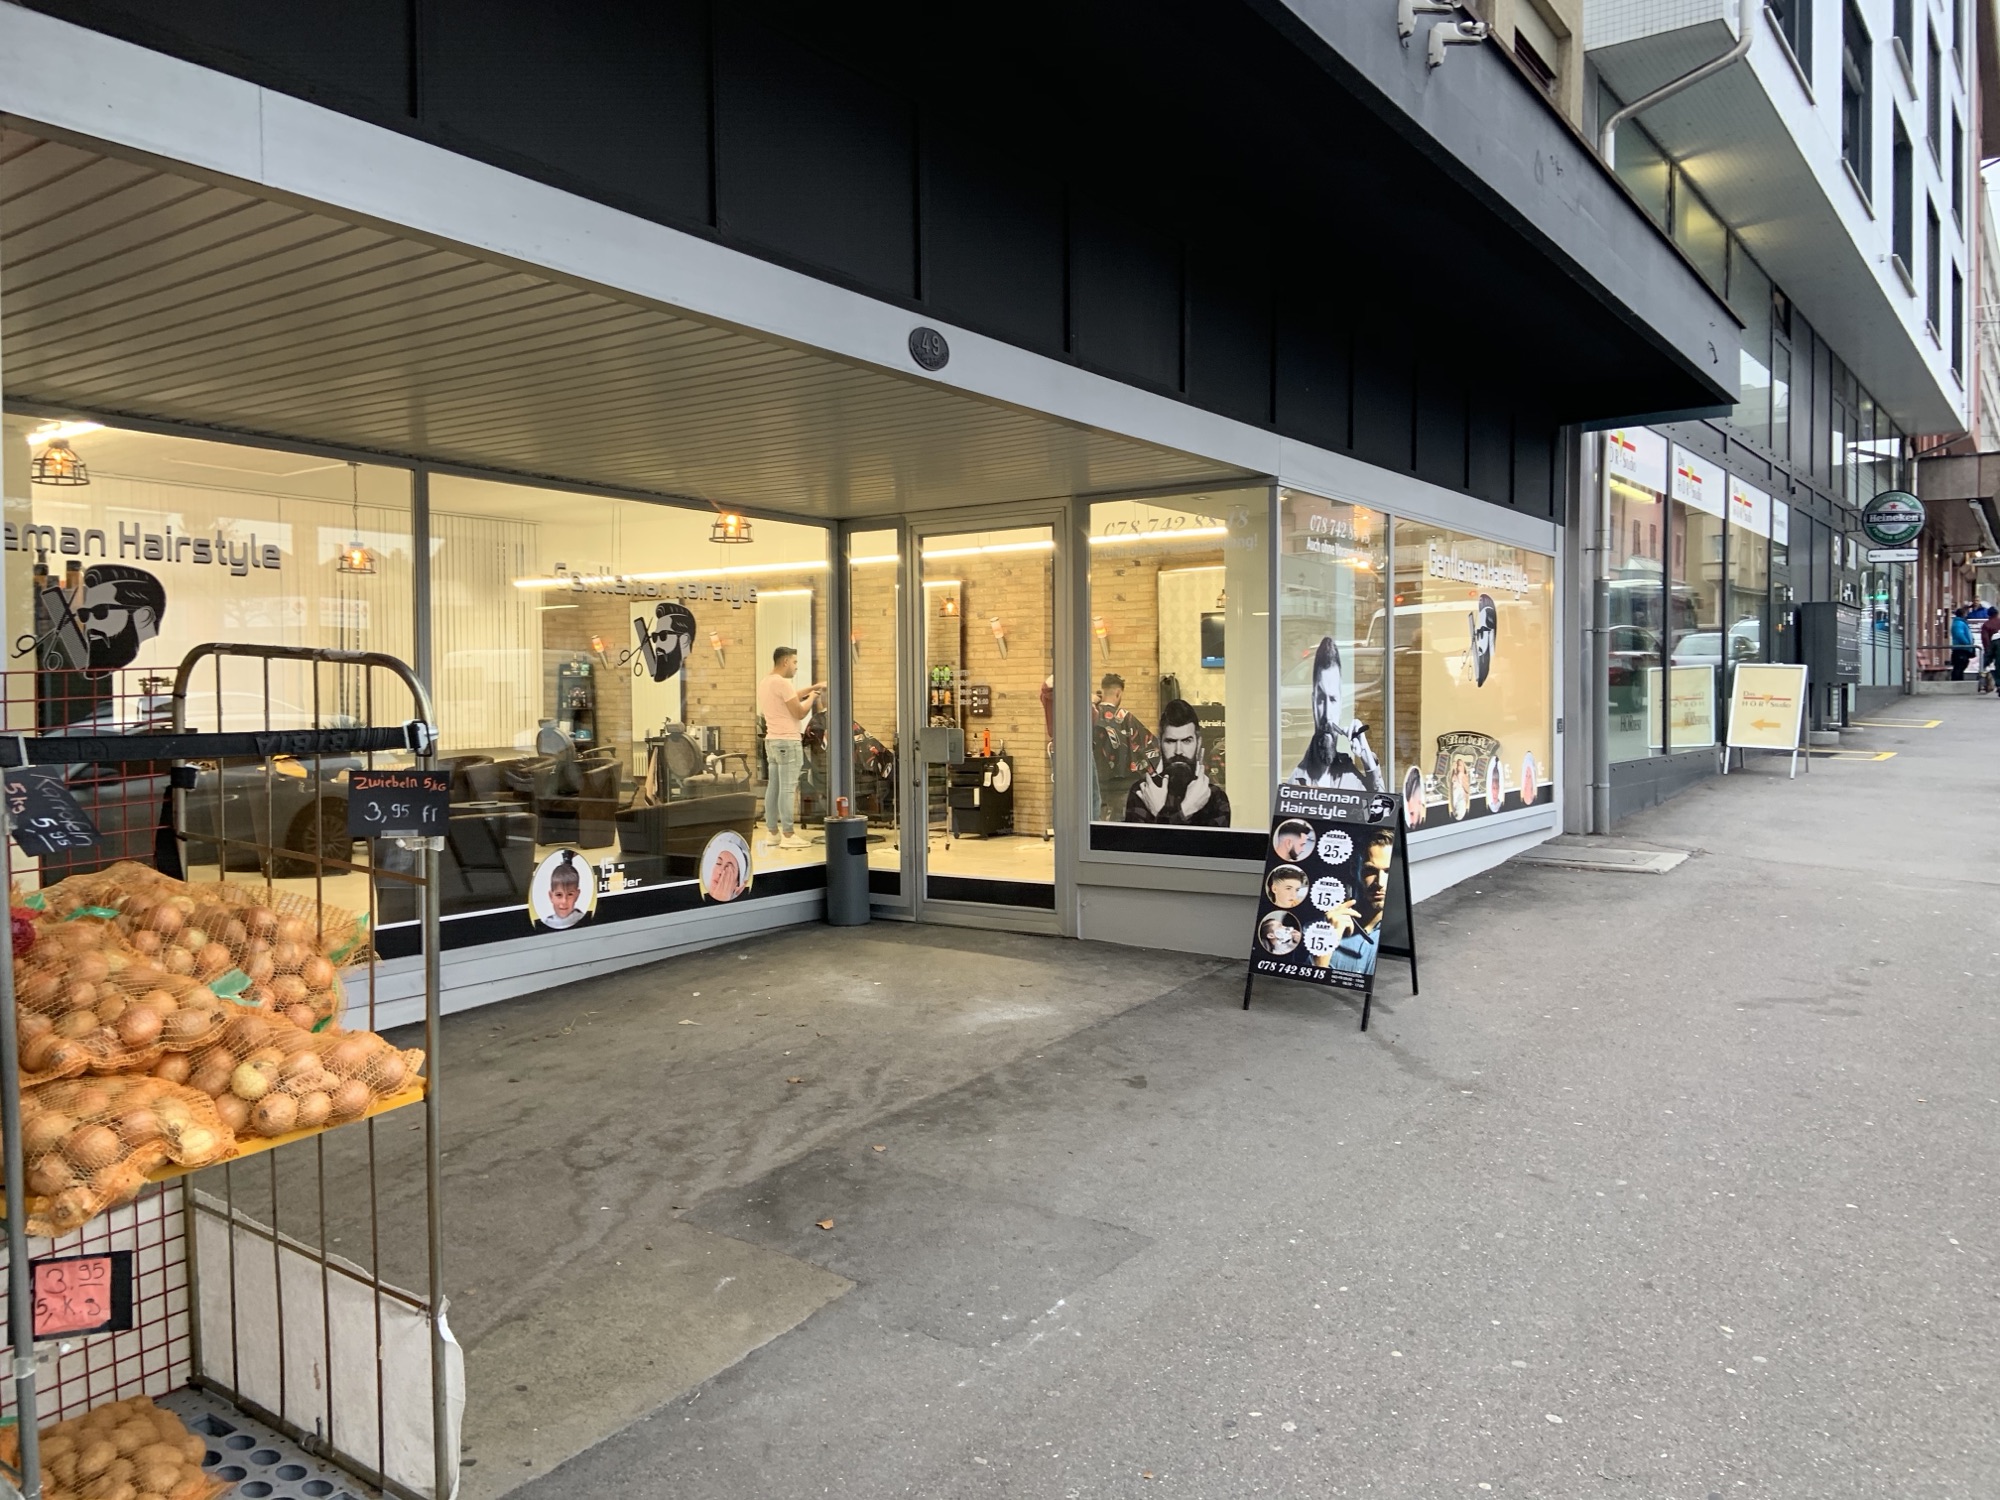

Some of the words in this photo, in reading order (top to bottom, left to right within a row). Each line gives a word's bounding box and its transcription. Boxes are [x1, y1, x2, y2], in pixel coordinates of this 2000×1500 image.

[1310, 514, 1328, 533] 078
[1329, 519, 1347, 539] 742
[1869, 513, 1919, 523] Heineken
[118, 521, 281, 576] Hairstyle
[1429, 543, 1486, 587] Gentleman
[1487, 557, 1528, 601] Hairstyle
[353, 776, 418, 791] Zwiebeln
[1280, 786, 1360, 805] Gentleman
[364, 801, 411, 823] 3,95
[1280, 800, 1347, 820] Hairstyle
[1323, 844, 1349, 859] 25.-
[1316, 892, 1340, 907] 15.-
[1310, 936, 1334, 952] 15.-
[1257, 959, 1277, 971] 078
[1278, 963, 1298, 975] 742
[1299, 966, 1313, 978] 88
[1313, 969, 1327, 980] 18
